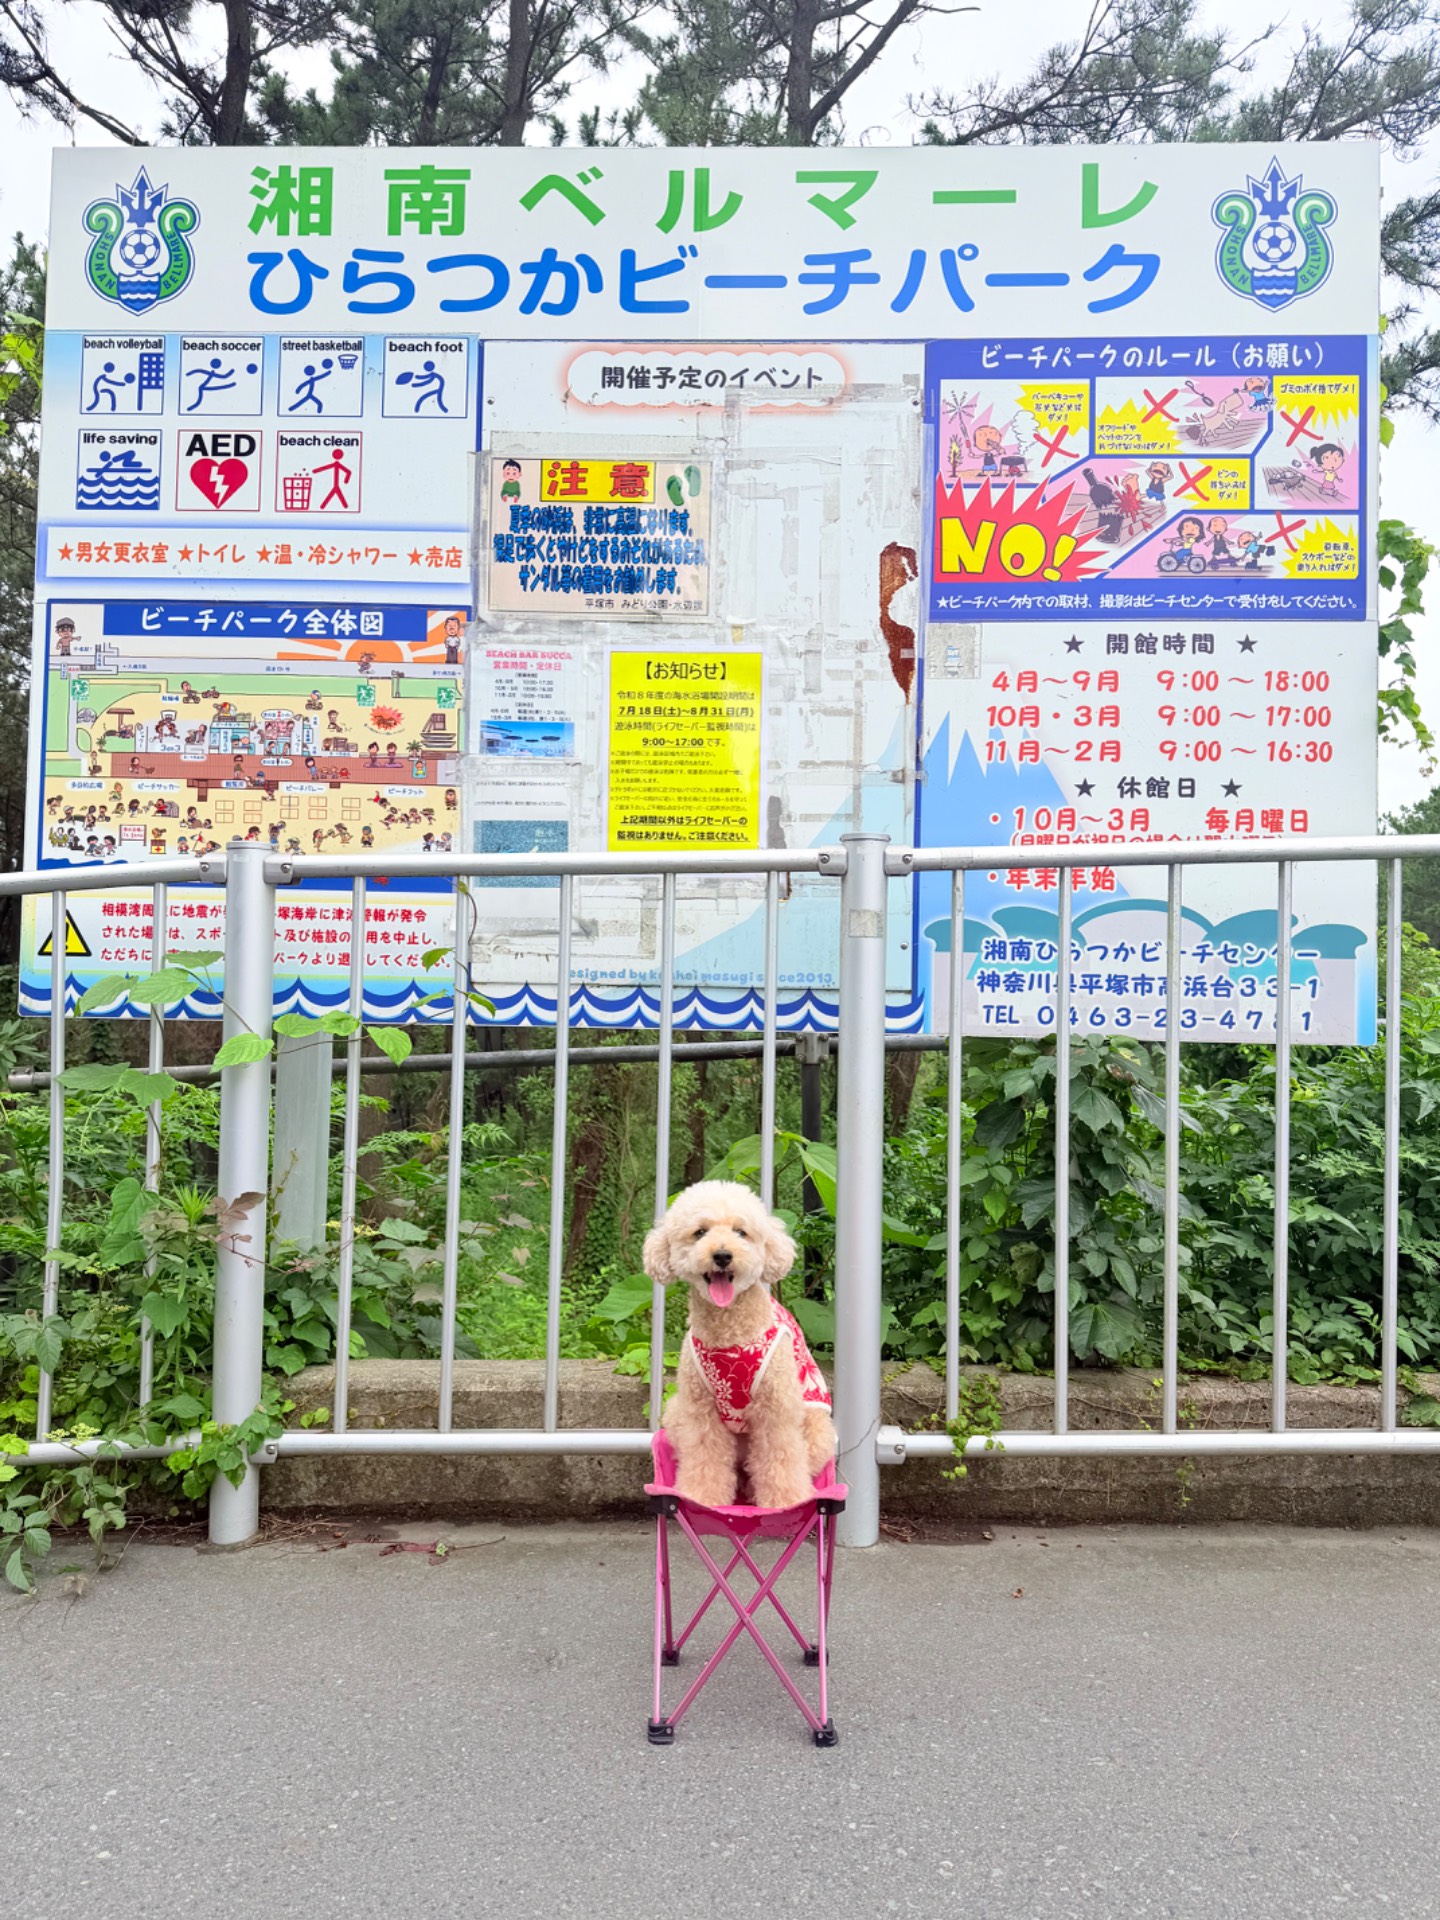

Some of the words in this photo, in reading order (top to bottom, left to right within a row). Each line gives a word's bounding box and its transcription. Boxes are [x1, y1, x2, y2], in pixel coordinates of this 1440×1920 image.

[247, 162, 1160, 237] 湘南ベルマーレ
[95, 231, 116, 290] SHONAN
[162, 231, 184, 290] BELLMARE
[1226, 225, 1250, 285] SHONAN
[1300, 224, 1322, 285] BELLMARE
[247, 244, 1161, 316] ひらつかビーチパーク
[83, 337, 115, 350] beach
[116, 338, 163, 351] volleyball
[182, 340, 219, 352] beach
[221, 341, 262, 352] soccer
[281, 341, 310, 352] street
[312, 340, 363, 353] basketball
[388, 341, 432, 353] beach
[434, 341, 463, 353] foot
[601, 365, 823, 390] 開催予定のイベント
[82, 433, 106, 445] life
[108, 434, 158, 446] saving
[185, 433, 257, 457] AED
[279, 435, 320, 447] beach
[322, 435, 360, 448] clean
[75, 541, 169, 564] 男女更衣室
[196, 543, 246, 563] トイレ
[425, 546, 464, 569] 売店
[939, 515, 1079, 582] NO!
[140, 607, 385, 638] ビーチパーク全体図
[1106, 633, 1215, 656] 開館時間
[645, 660, 727, 681] 【お知らせ】
[1116, 777, 1198, 800] 休館日
[1204, 806, 1309, 833] 毎月曜日
[569, 968, 627, 982] esigned
[982, 1004, 1020, 1025] TEL
